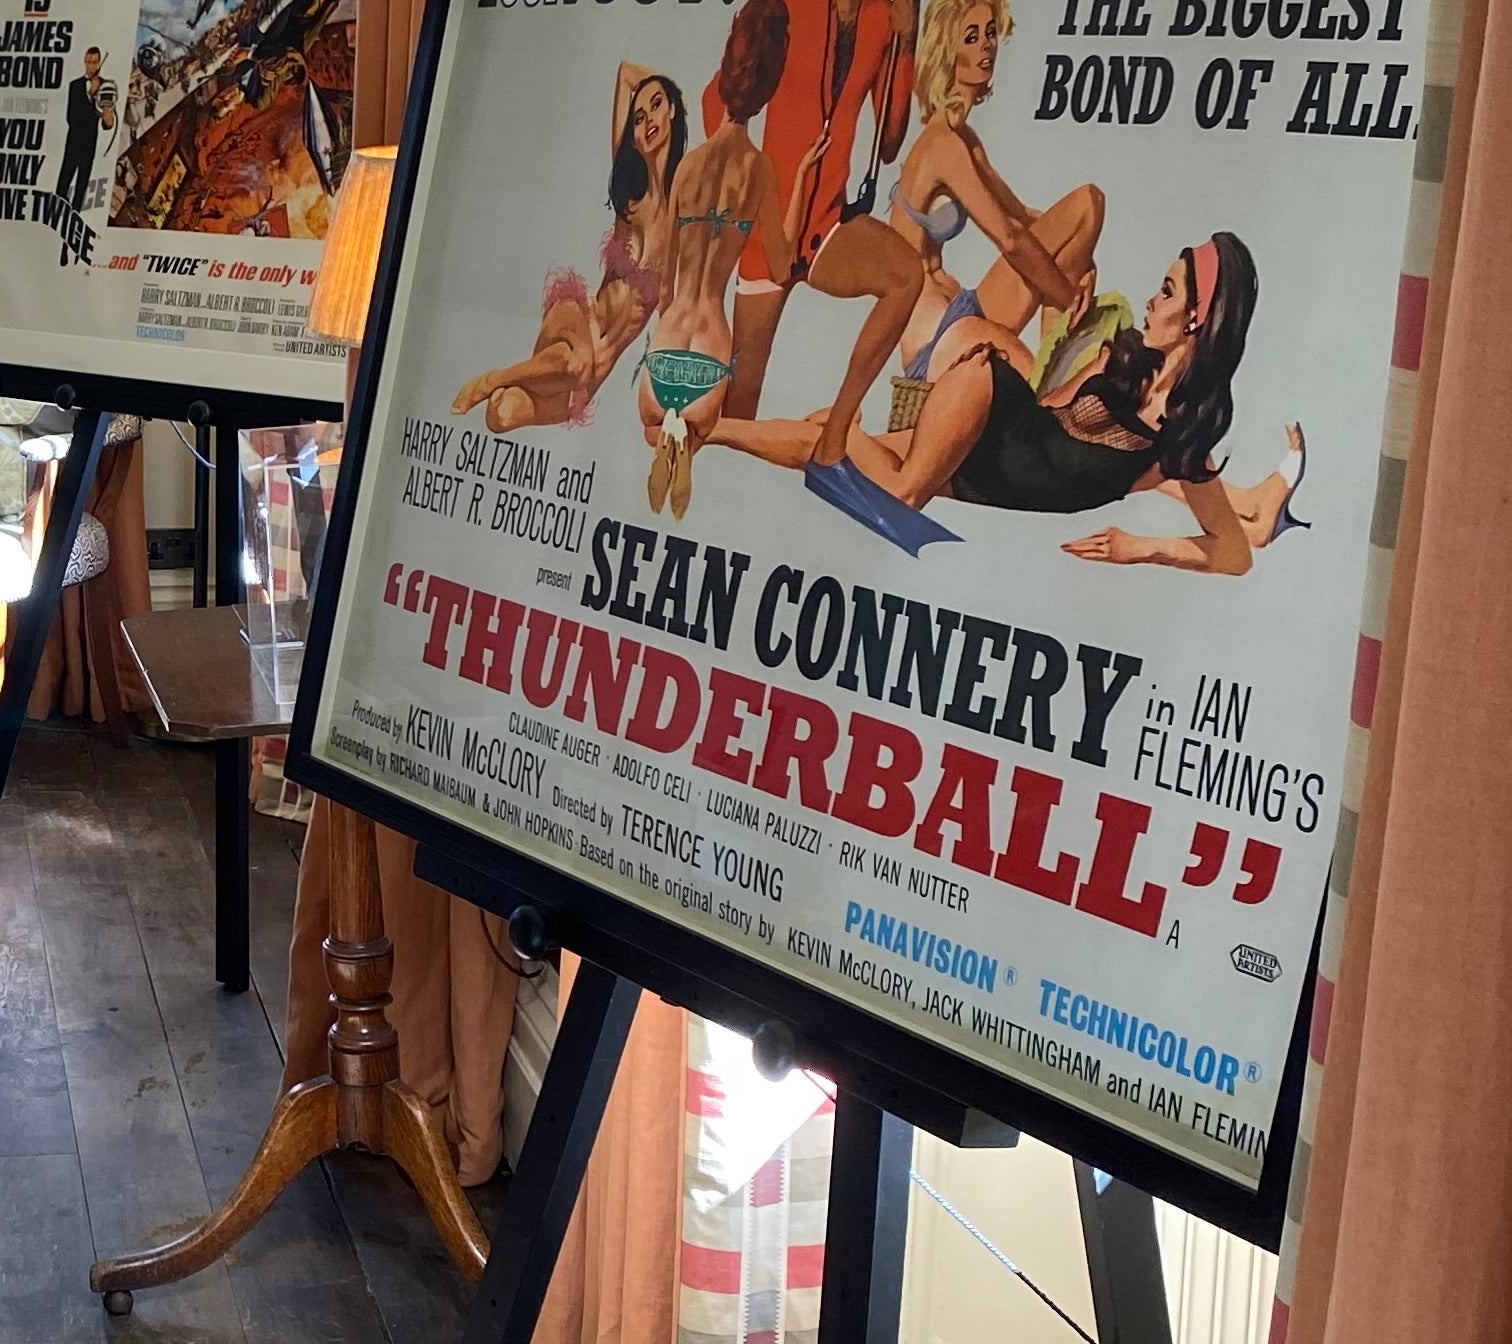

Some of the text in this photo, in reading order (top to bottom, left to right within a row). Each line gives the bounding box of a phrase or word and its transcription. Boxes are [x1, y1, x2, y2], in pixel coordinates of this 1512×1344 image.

[1034, 55, 1418, 140] BOND OF ALL
[208, 260, 225, 278] is
[228, 262, 255, 281] the
[259, 265, 297, 287] only
[401, 417, 596, 504] HARRY SALTZMAN and
[403, 466, 586, 554] ALBERT R. BROCCOLI
[536, 517, 1252, 767] present SEAN CONNERY in IAN
[352, 699, 784, 903] Produced by KEVIN McCLORY Directed by TERENCE YOUNG
[509, 711, 970, 913] CLAUDINE AUGER ADOLFO CELI LUCIANA PALUZZI RIK VAN NUTTER
[1134, 726, 1324, 833] FLEMING'S
[329, 726, 1271, 1159] Screenplay by RICHARD MAIBAUM & JOHN HOPKINS Based on the original story by KEVIN McCLORY, JACK WHITTINGHAM and IAN FLEMIN
[1165, 919, 1181, 949] A
[1236, 958, 1275, 980] ARTISTS
[1238, 946, 1278, 969] UNITED
